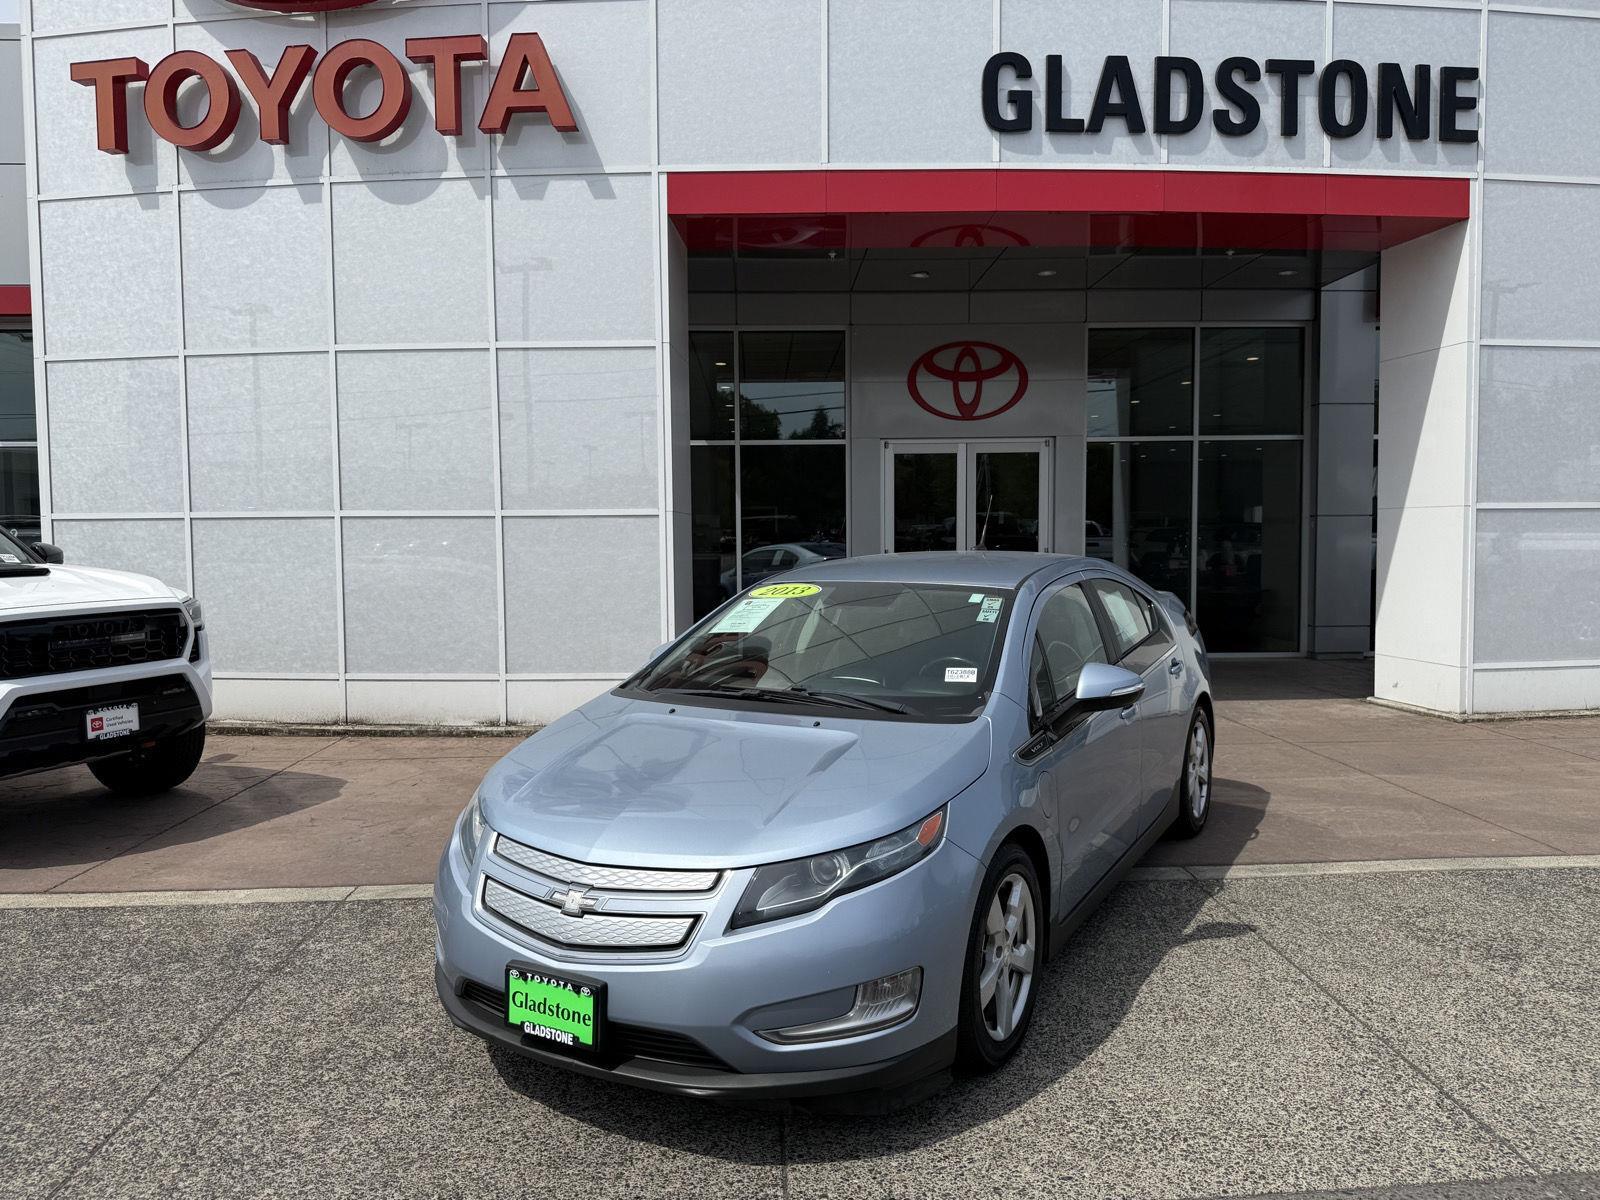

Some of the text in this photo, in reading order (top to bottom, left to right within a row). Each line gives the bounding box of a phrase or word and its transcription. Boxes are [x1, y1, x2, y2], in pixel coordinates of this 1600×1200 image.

[70, 32, 579, 154] TOYOTA
[982, 52, 1479, 143] GLADSTONE
[758, 586, 812, 596] 2013
[99, 730, 131, 740] GLADSTONE
[526, 973, 573, 991] TOYOTA
[511, 990, 592, 1027] Gladstone
[524, 1022, 573, 1045] GLADSTONE
